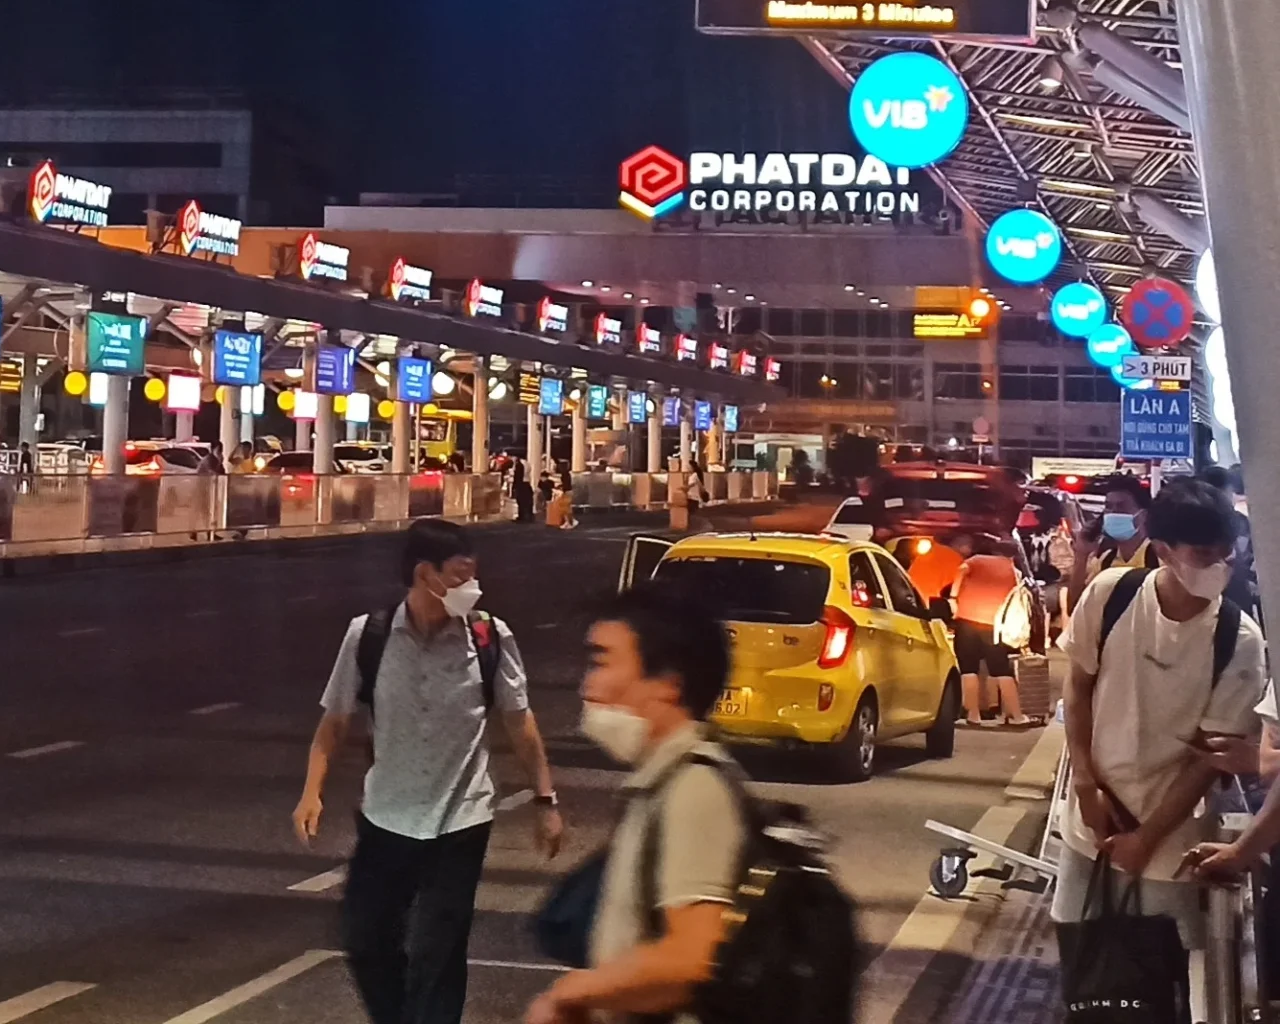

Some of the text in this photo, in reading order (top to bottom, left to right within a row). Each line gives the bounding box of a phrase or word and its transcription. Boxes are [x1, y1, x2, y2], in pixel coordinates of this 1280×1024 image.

[862, 3, 875, 21] 3
[863, 98, 928, 130] VIB
[689, 189, 919, 212] CORPORATION
[1141, 362, 1149, 375] 3
[1169, 399, 1180, 415] A
[1120, 999, 1140, 1009] DC
